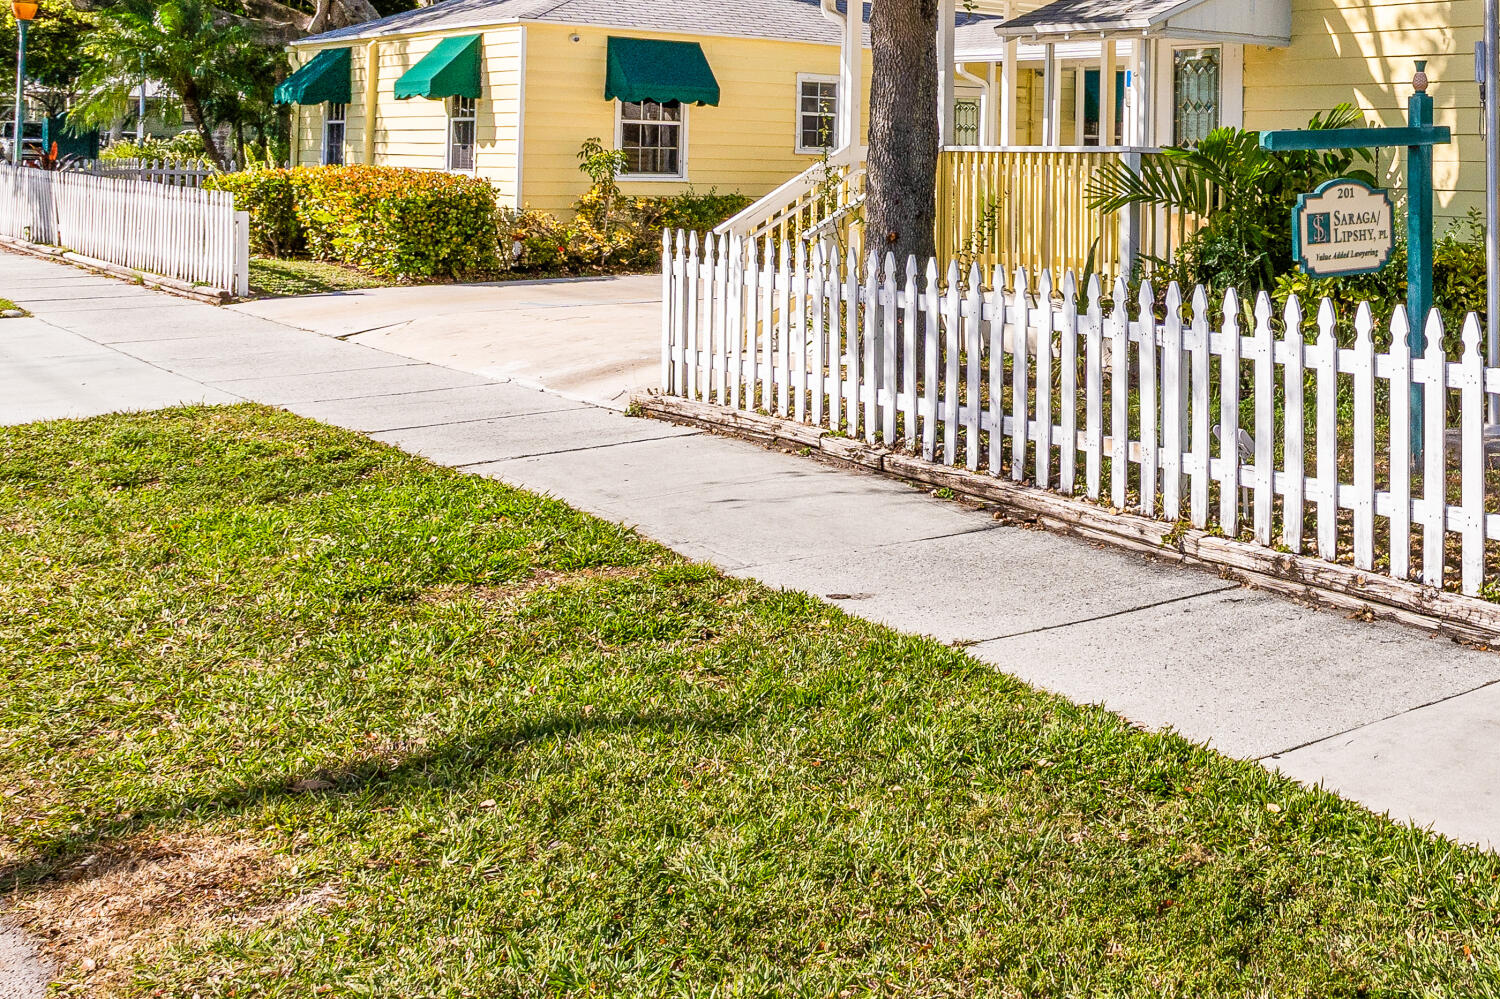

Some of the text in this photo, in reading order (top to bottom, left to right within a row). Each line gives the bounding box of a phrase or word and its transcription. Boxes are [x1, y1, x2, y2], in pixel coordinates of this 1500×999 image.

[1337, 187, 1355, 199] 201
[1333, 227, 1389, 243] LIPSHY, PL
[1316, 248, 1379, 261] Value Added Lawyering
